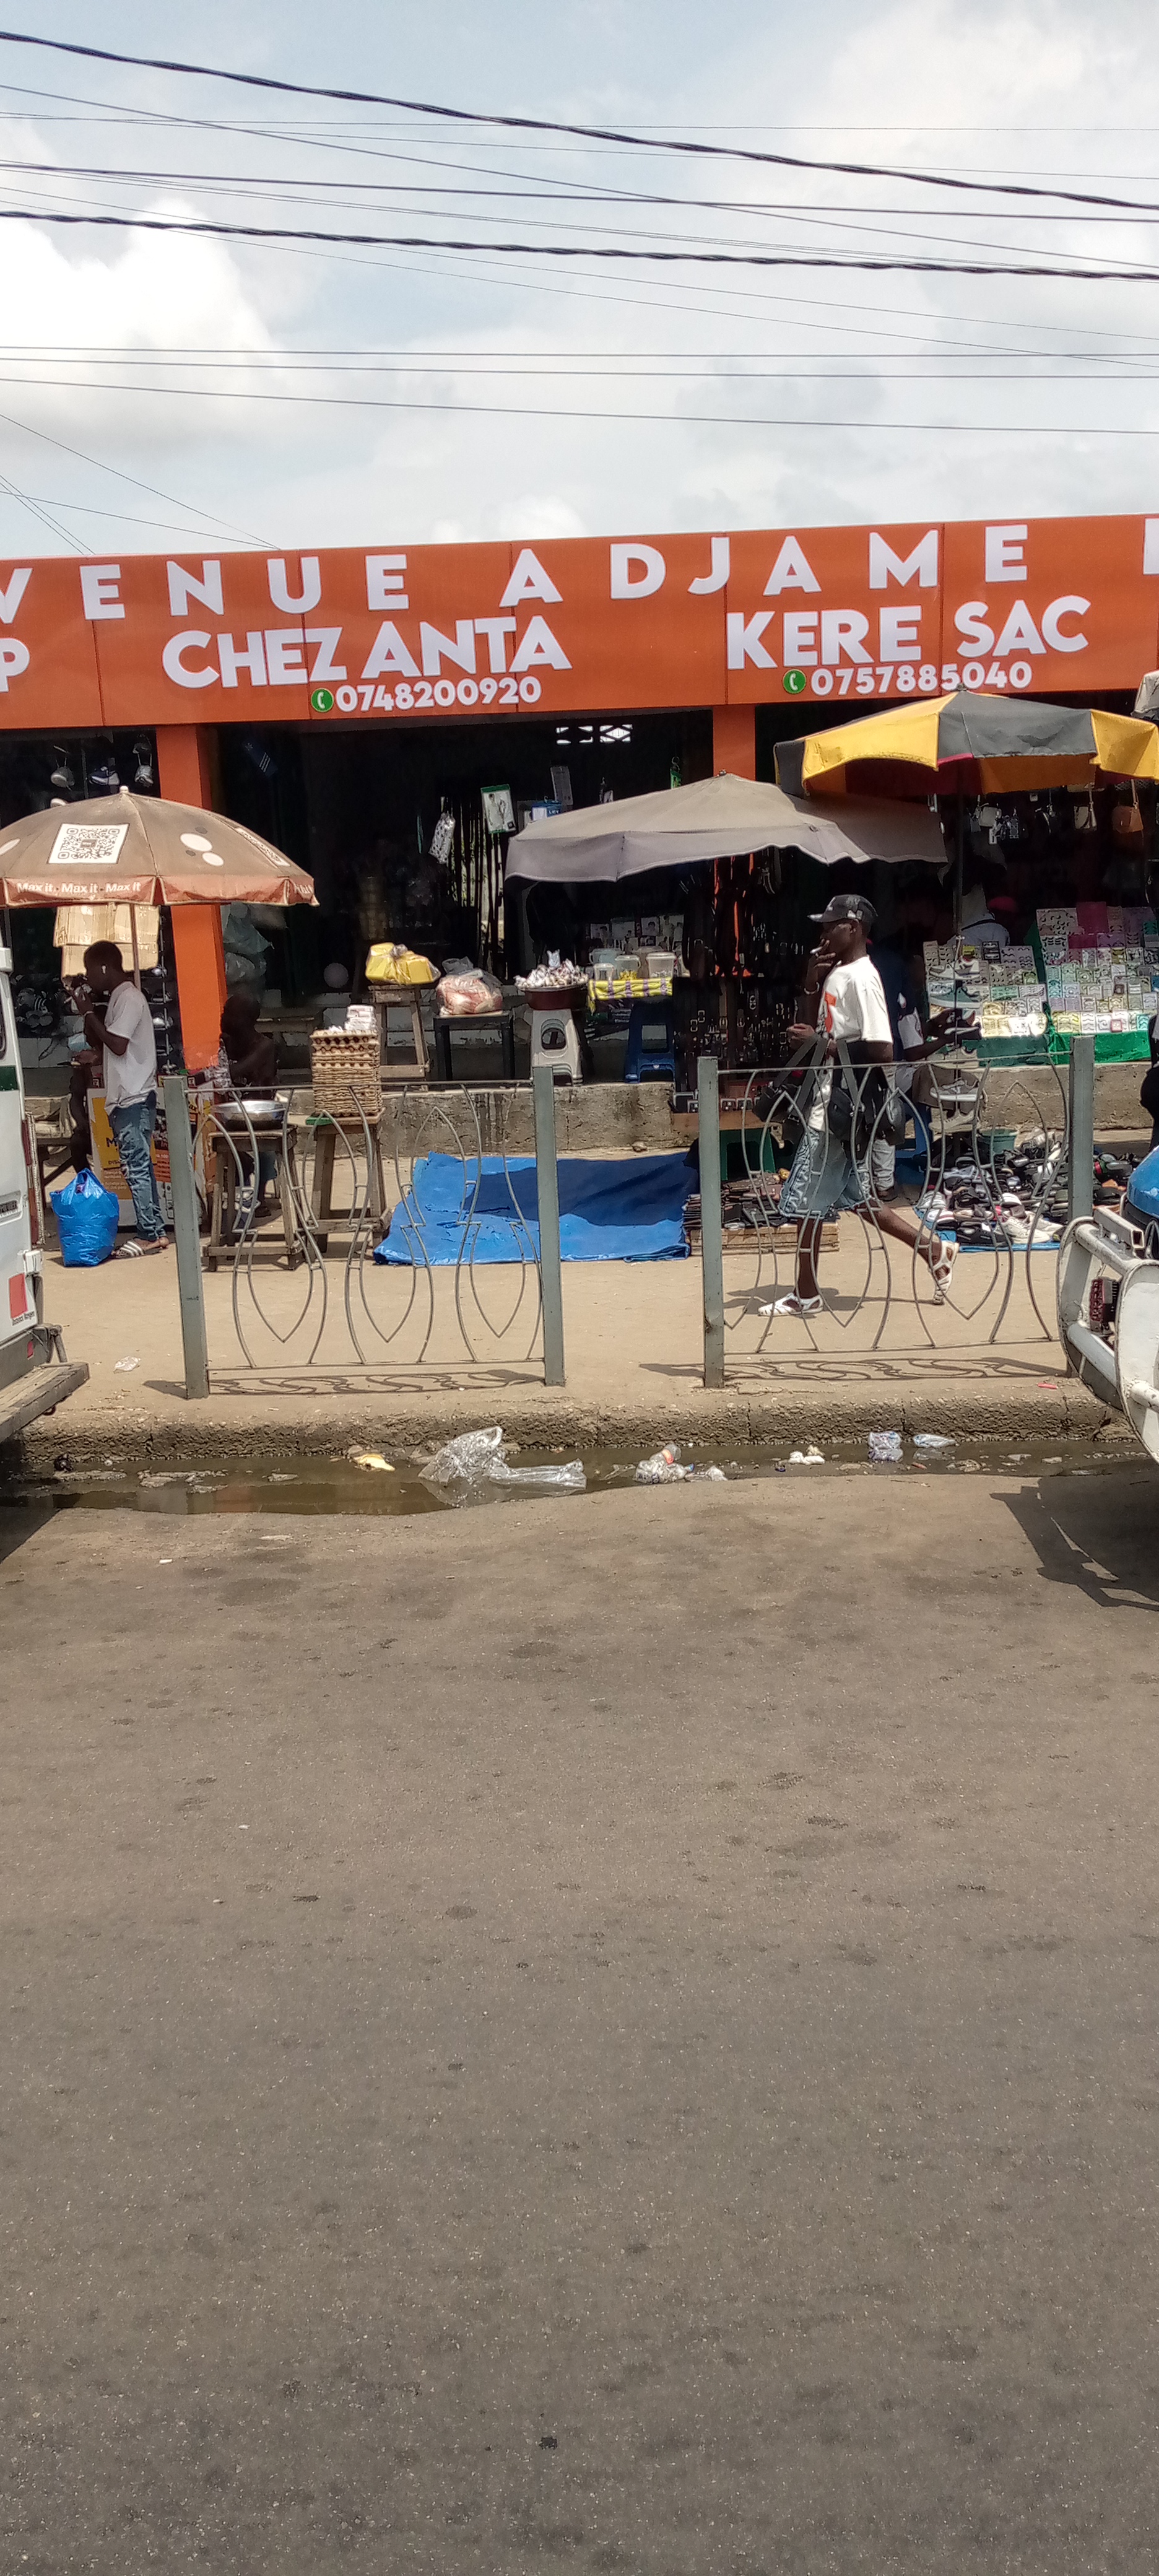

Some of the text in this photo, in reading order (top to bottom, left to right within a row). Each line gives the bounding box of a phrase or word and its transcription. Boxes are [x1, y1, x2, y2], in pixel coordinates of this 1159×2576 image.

[500, 524, 1028, 607] ADJAME
[162, 616, 573, 689] CHEZ ANTA
[727, 595, 1091, 670] KERE SAC
[336, 677, 542, 712] 0748200920
[811, 661, 1032, 696] 0757885040
[17, 881, 141, 893] Max it Max it Max it
